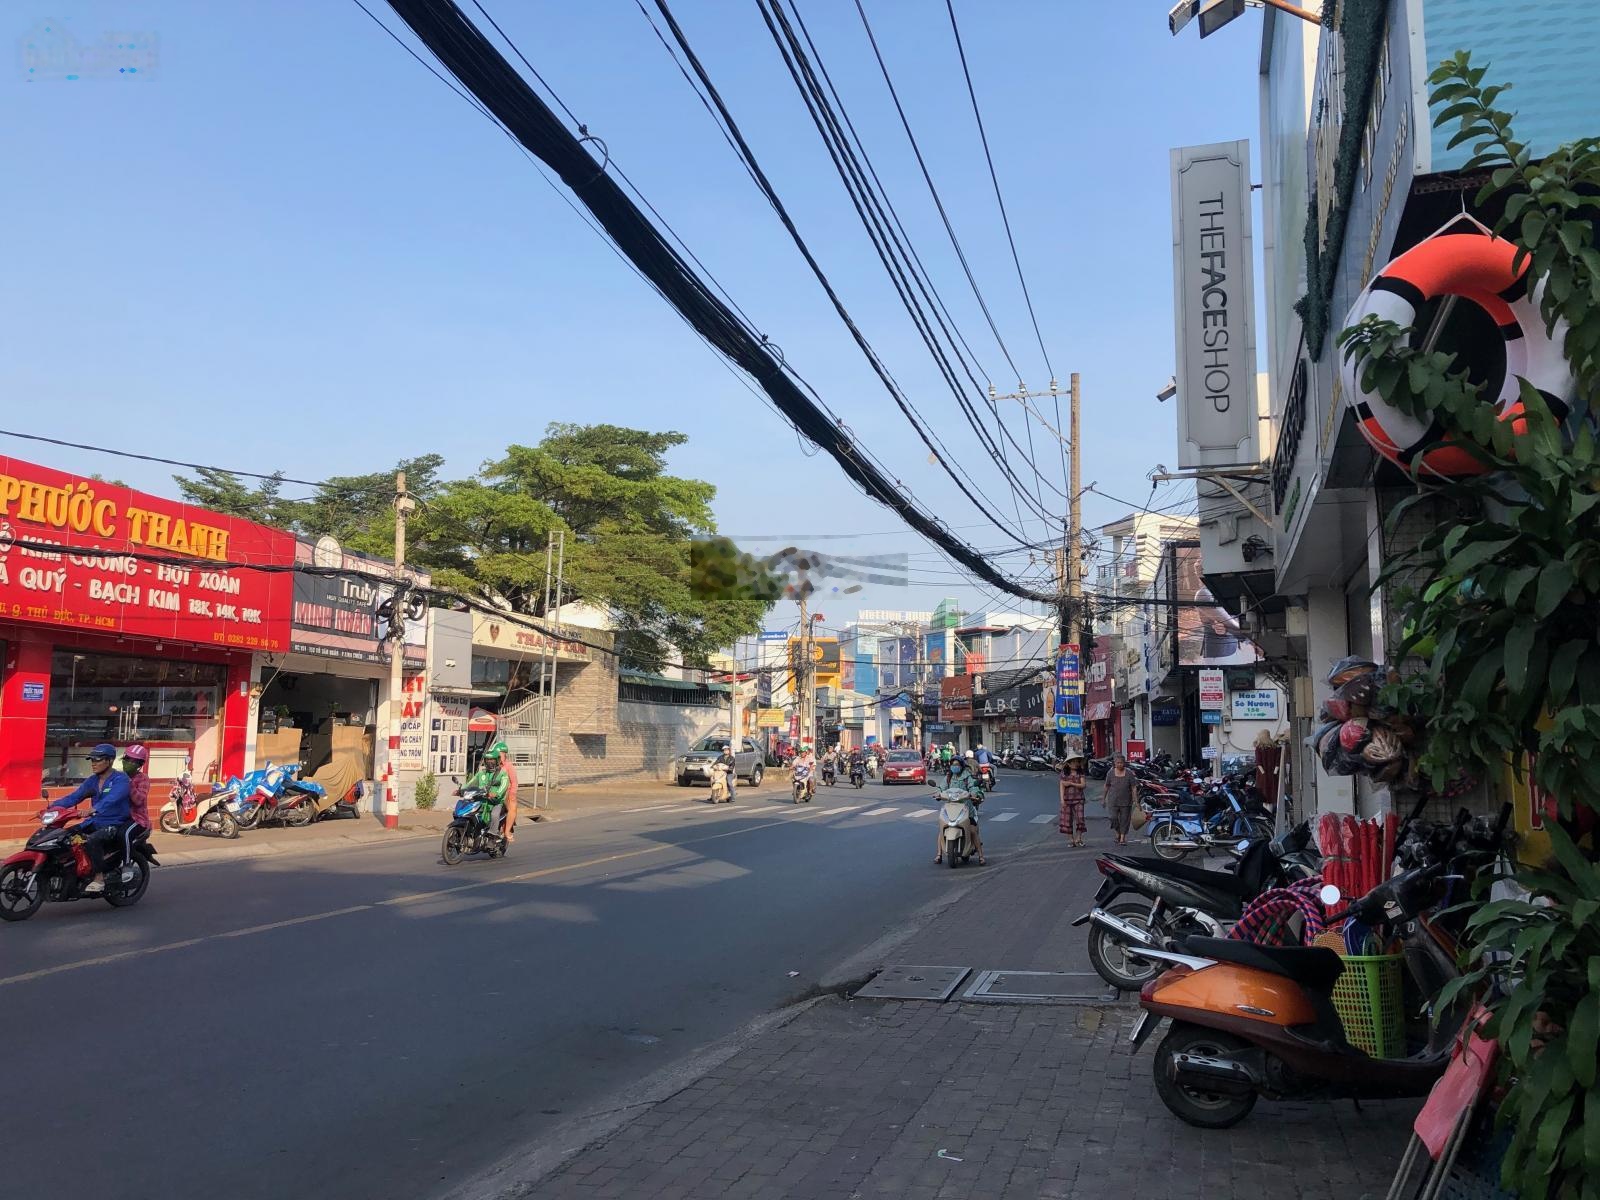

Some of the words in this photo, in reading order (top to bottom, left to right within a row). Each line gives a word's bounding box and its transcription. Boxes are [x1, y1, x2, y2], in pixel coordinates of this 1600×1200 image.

[0, 474, 117, 538] PHƯỚC
[126, 507, 231, 561] THANH
[20, 567, 67, 593] QUÝ
[89, 579, 140, 605] BẠCH
[148, 588, 181, 612] KIM
[340, 577, 376, 606] Truly
[95, 615, 115, 627] HCM
[295, 601, 333, 629] MINH
